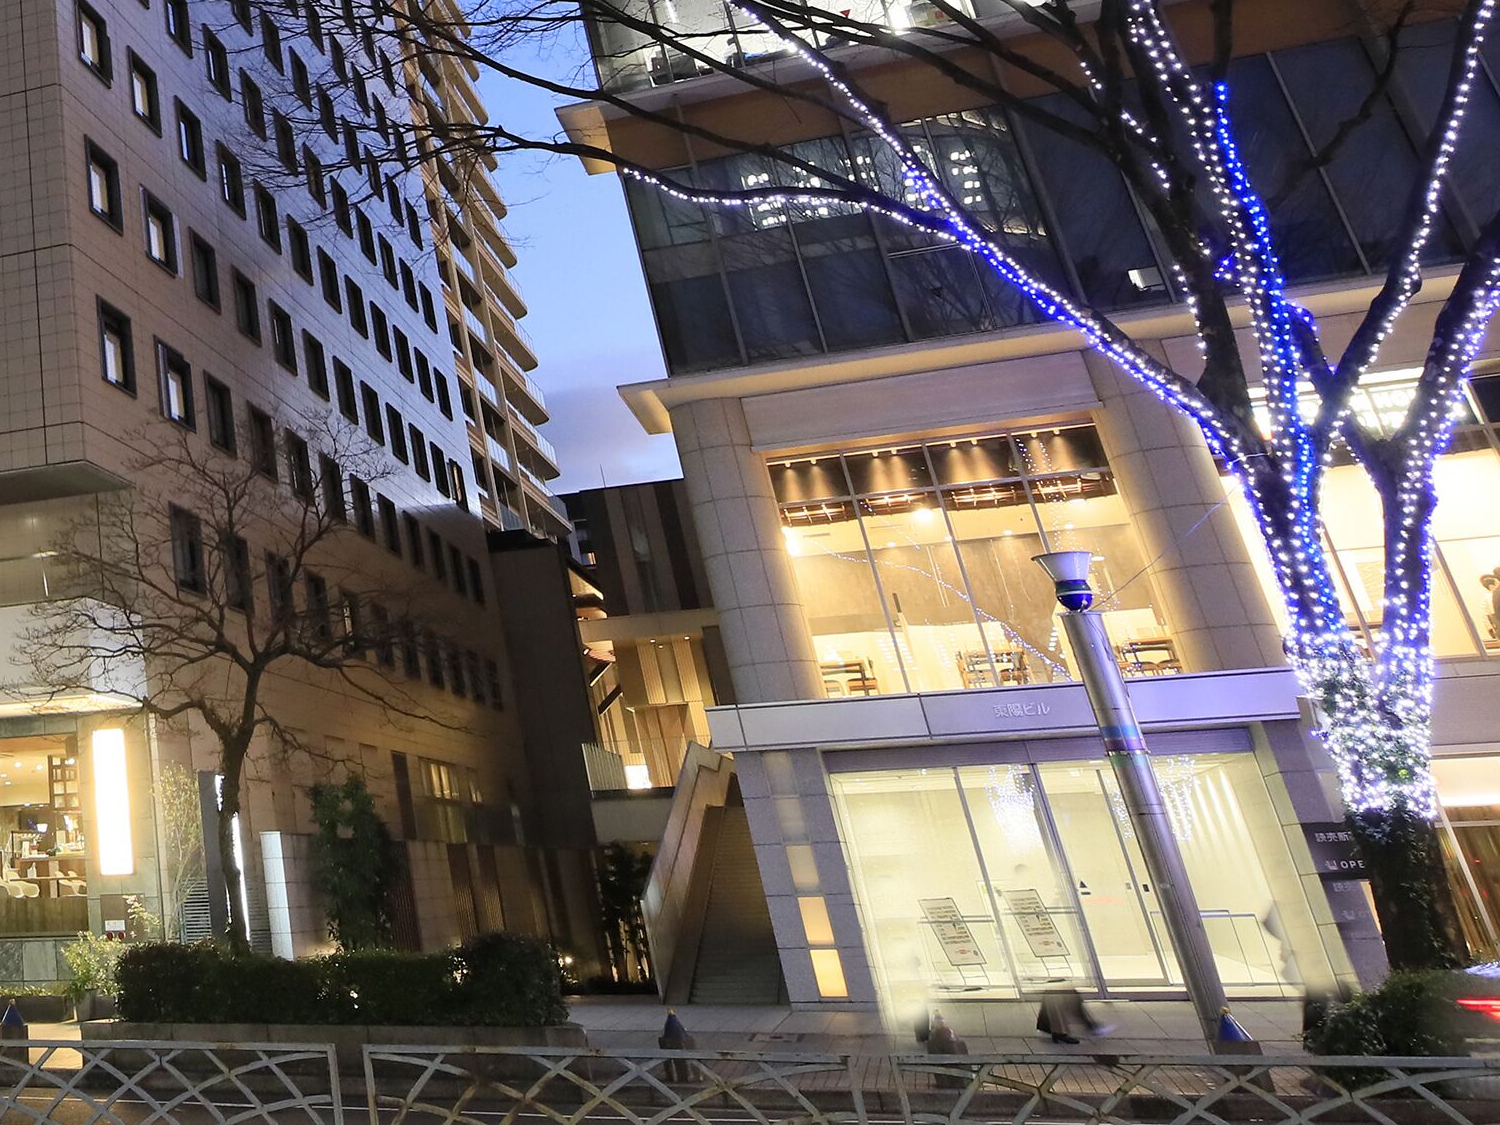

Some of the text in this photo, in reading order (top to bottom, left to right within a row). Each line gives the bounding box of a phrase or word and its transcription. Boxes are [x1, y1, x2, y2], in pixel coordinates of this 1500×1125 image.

[992, 701, 1051, 718] 東陽ビル
[1315, 832, 1352, 842] 読売新
